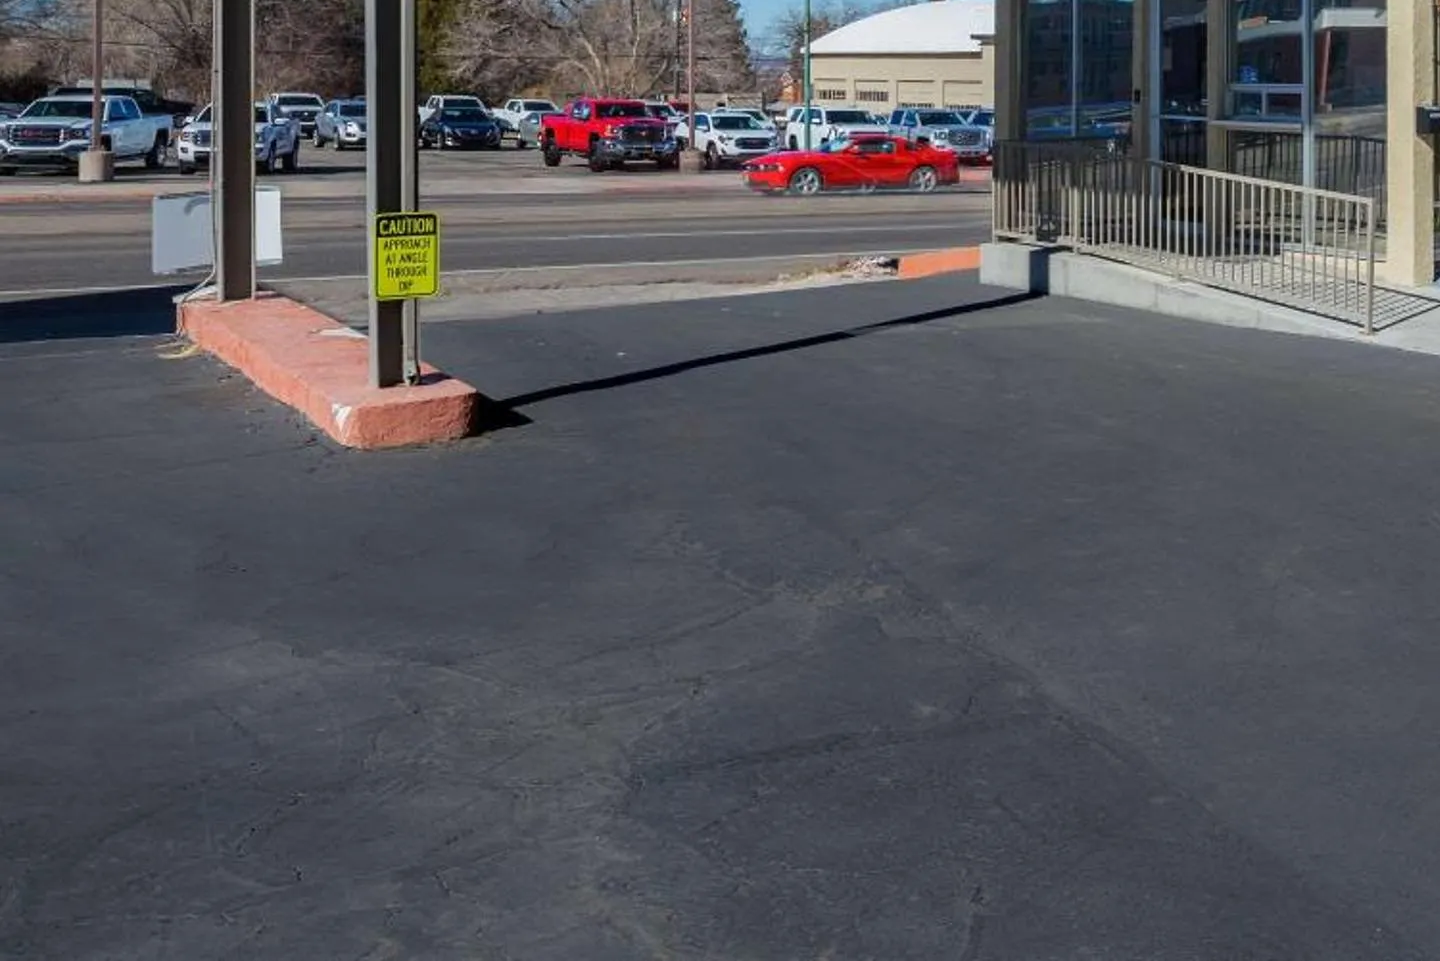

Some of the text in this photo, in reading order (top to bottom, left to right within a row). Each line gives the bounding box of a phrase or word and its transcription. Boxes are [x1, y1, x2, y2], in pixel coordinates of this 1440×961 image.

[380, 218, 434, 235] CAUTION
[384, 238, 430, 250] APPROACH
[386, 251, 429, 264] AT ANGLE
[387, 265, 427, 278] THROUGH
